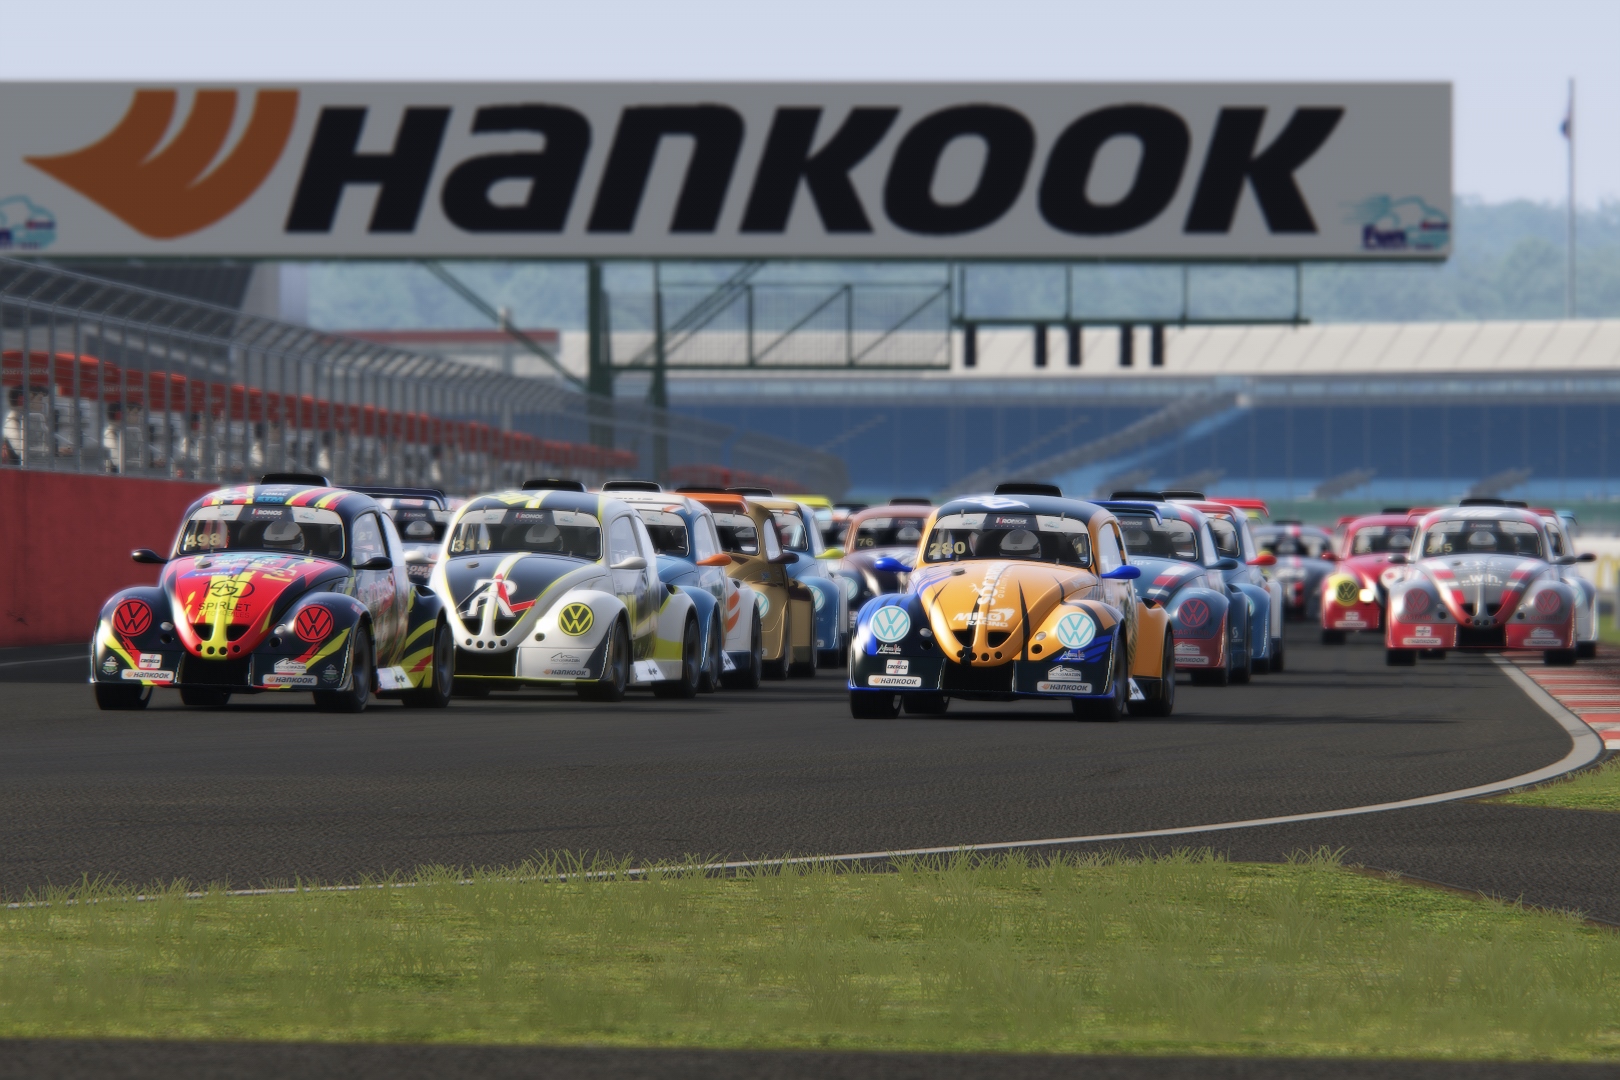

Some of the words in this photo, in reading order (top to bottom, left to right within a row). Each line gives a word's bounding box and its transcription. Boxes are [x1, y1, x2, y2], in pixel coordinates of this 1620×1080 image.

[2, 367, 28, 375] ASSETT
[251, 508, 284, 516] KRONOS
[186, 533, 221, 547] 498
[857, 537, 874, 547] 76
[928, 541, 966, 556] 280
[198, 602, 251, 612] SPIRLET
[965, 620, 1008, 628] RACING
